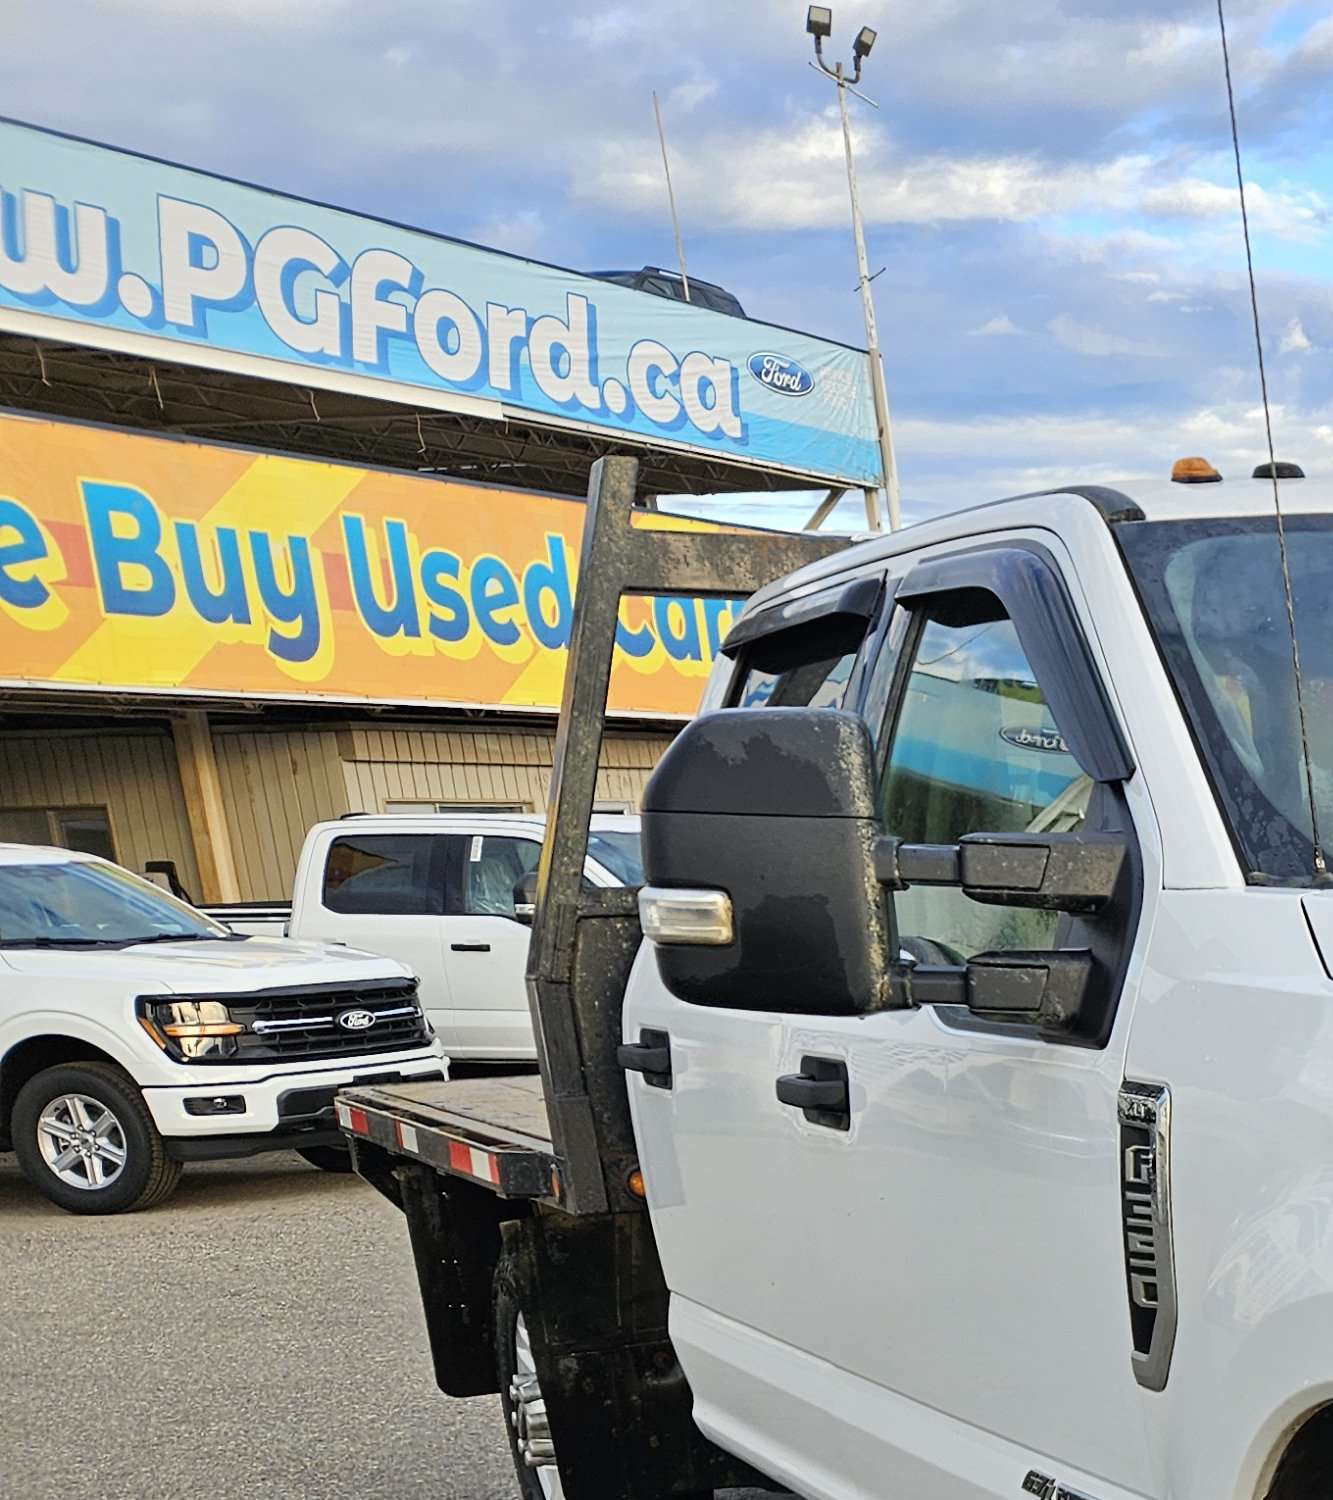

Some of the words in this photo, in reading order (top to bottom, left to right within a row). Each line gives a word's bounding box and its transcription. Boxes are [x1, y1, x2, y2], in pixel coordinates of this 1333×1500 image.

[760, 355, 802, 391] Ford
[79, 479, 321, 663] Buy
[341, 513, 573, 651] Used
